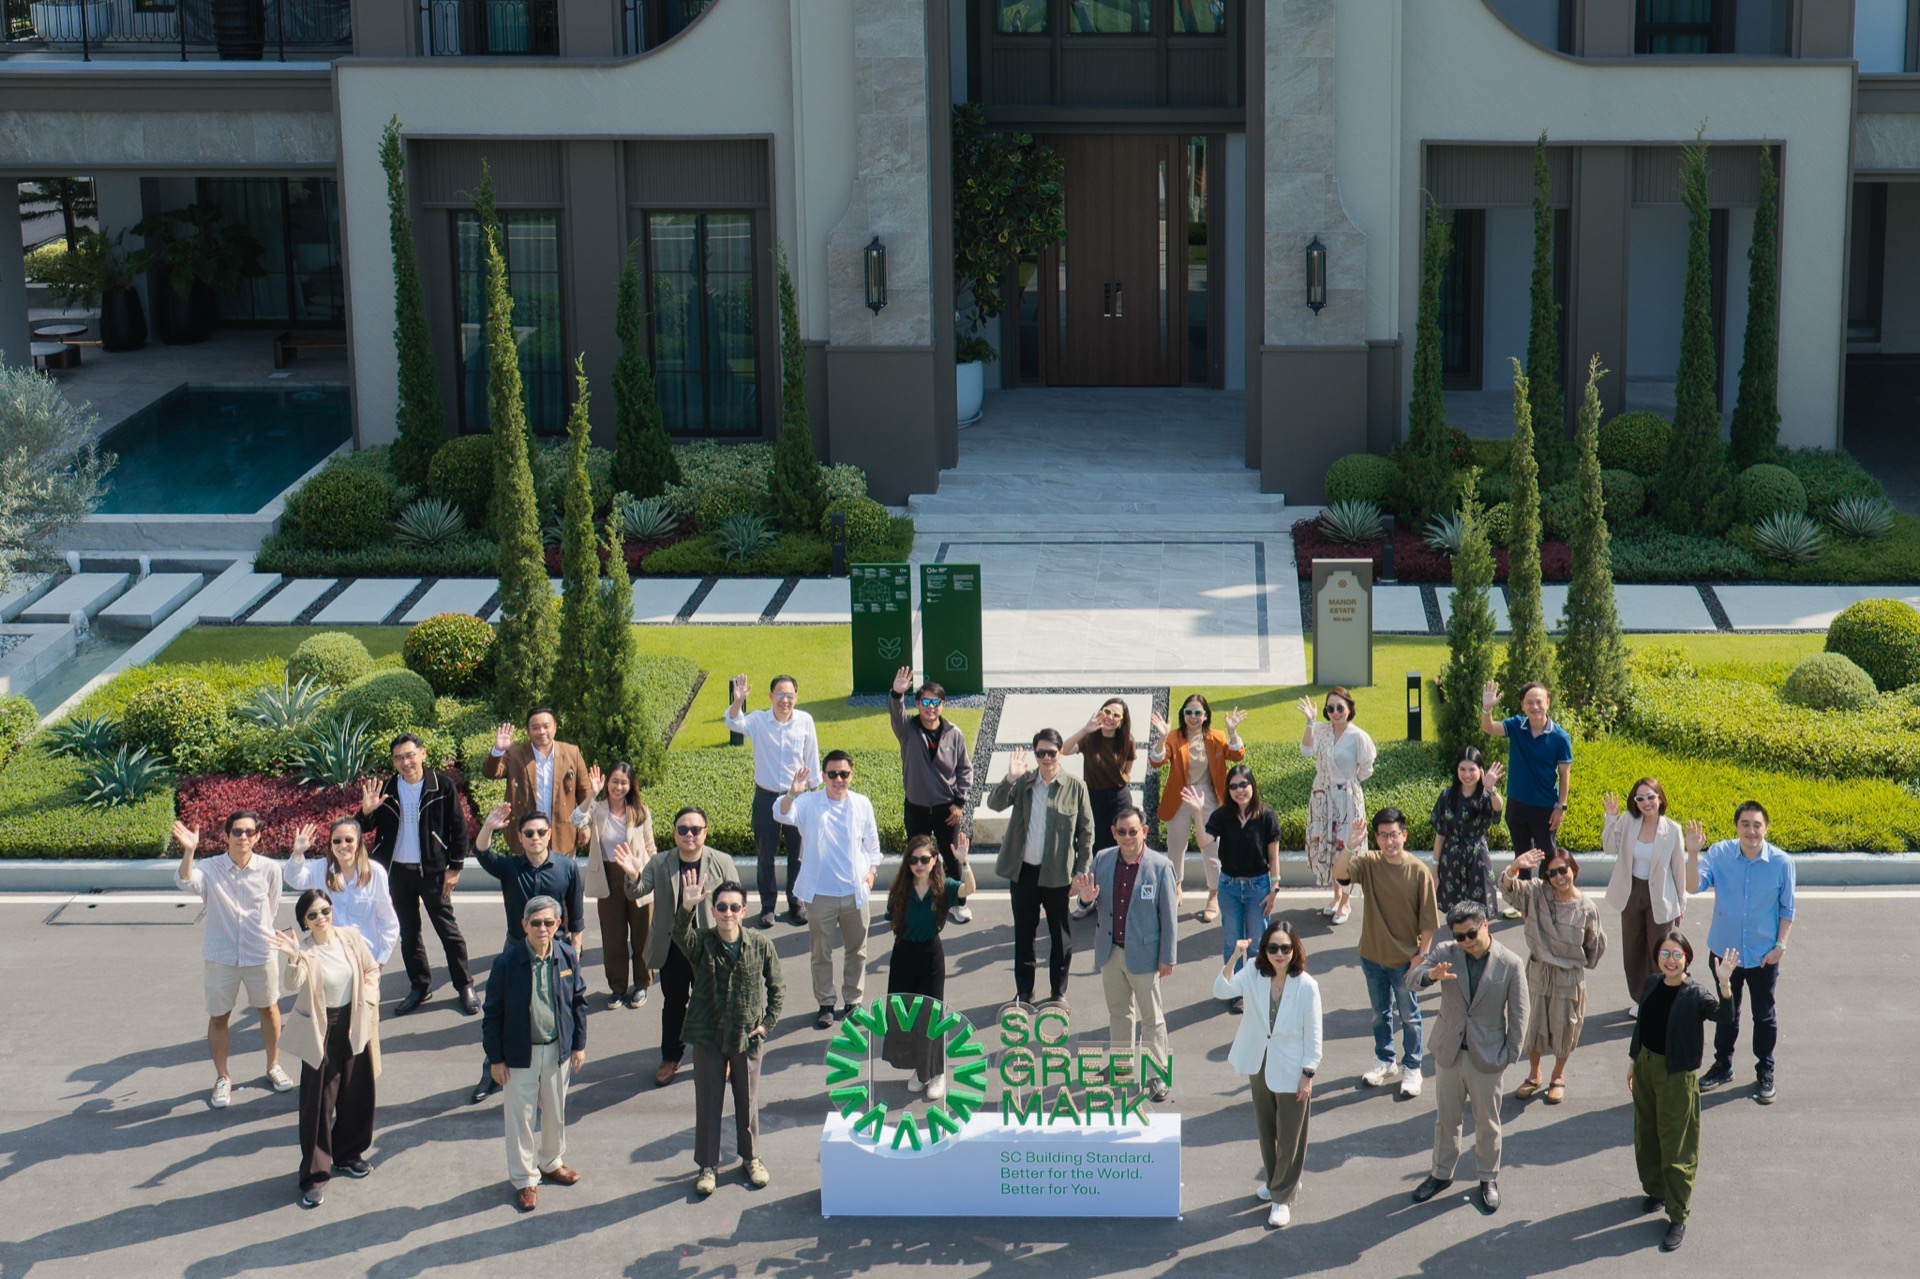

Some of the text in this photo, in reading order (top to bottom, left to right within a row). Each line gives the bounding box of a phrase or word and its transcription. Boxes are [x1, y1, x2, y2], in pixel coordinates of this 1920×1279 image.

[1000, 1006, 1070, 1048] SC
[1000, 1047, 1173, 1087] GREEN
[1002, 1086, 1150, 1126] MARK
[1000, 1151, 1155, 1166] SC Building Standard.
[1001, 1167, 1143, 1180] Better for the World.
[1001, 1183, 1101, 1196] Better for You.
